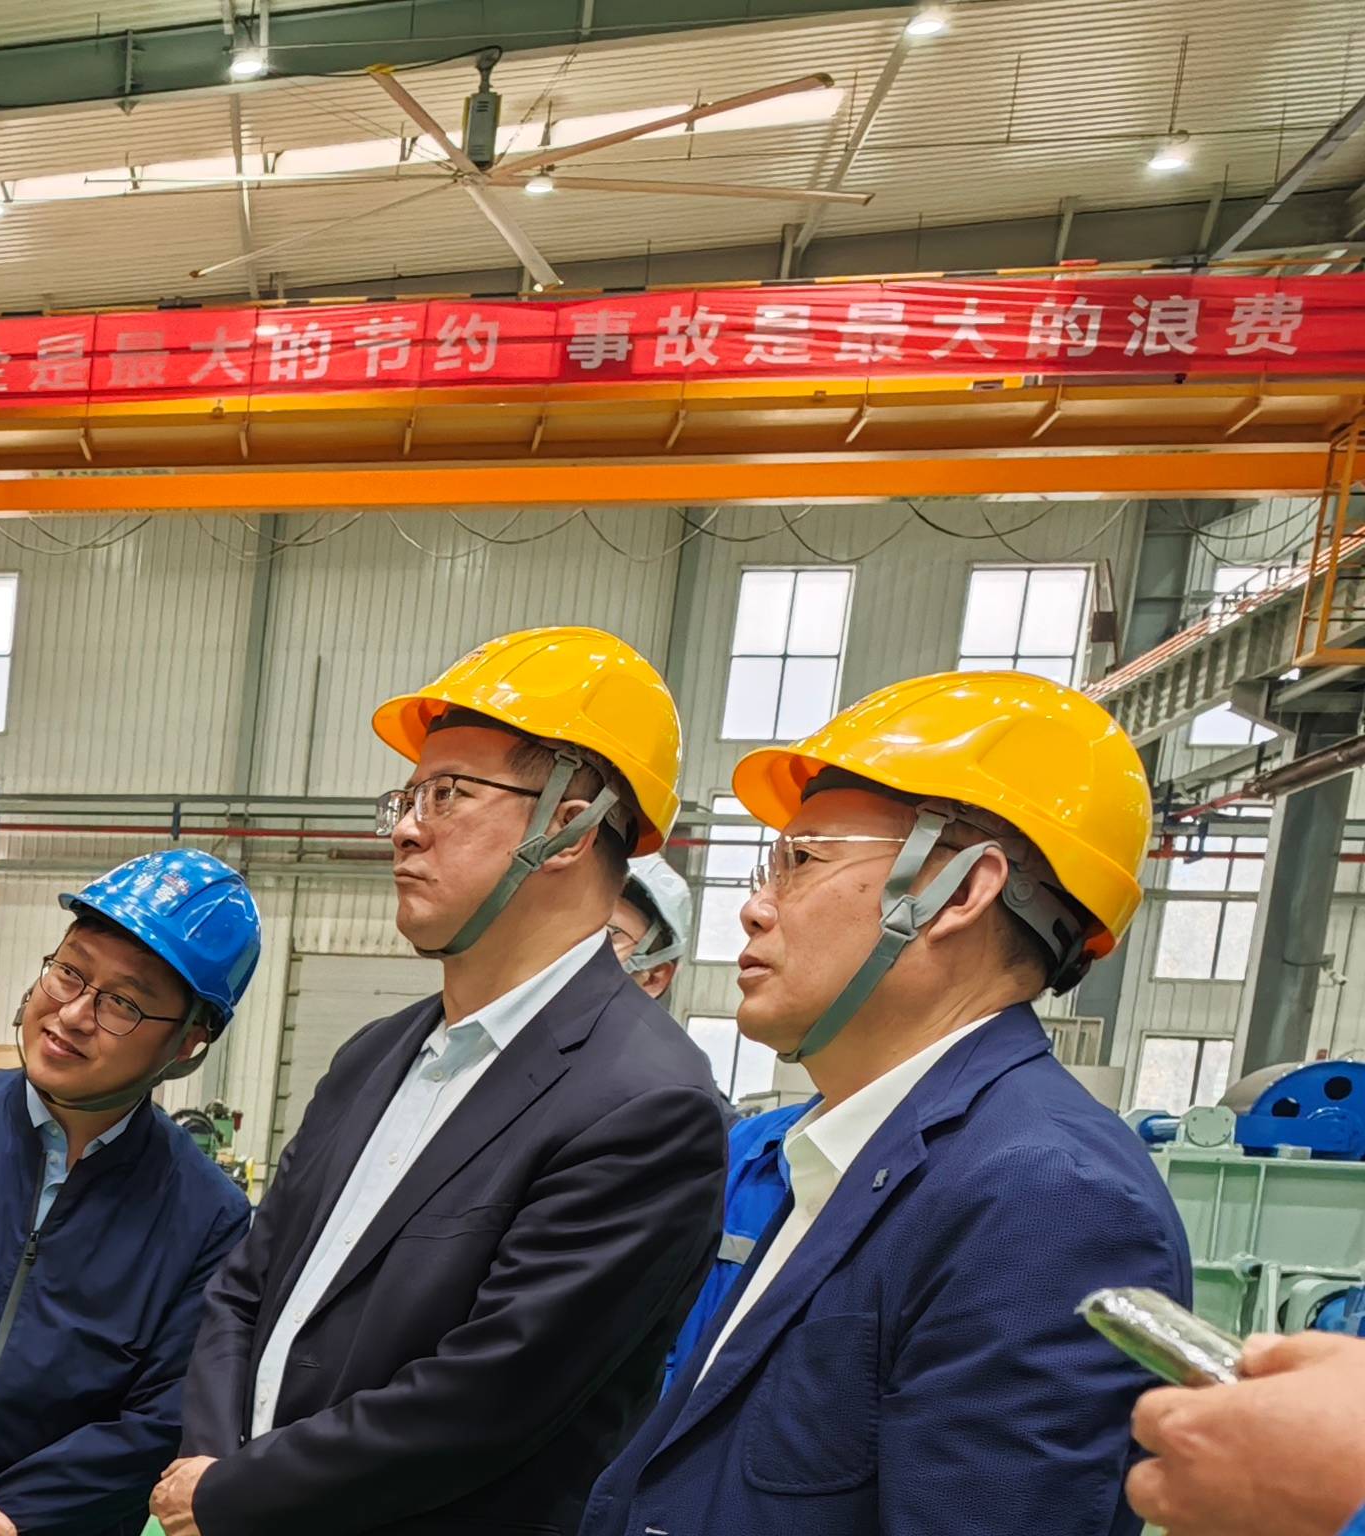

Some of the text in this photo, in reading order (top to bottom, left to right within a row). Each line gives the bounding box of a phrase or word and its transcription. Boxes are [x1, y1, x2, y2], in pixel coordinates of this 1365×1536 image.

[567, 292, 1305, 370] 事故是最大的浪费
